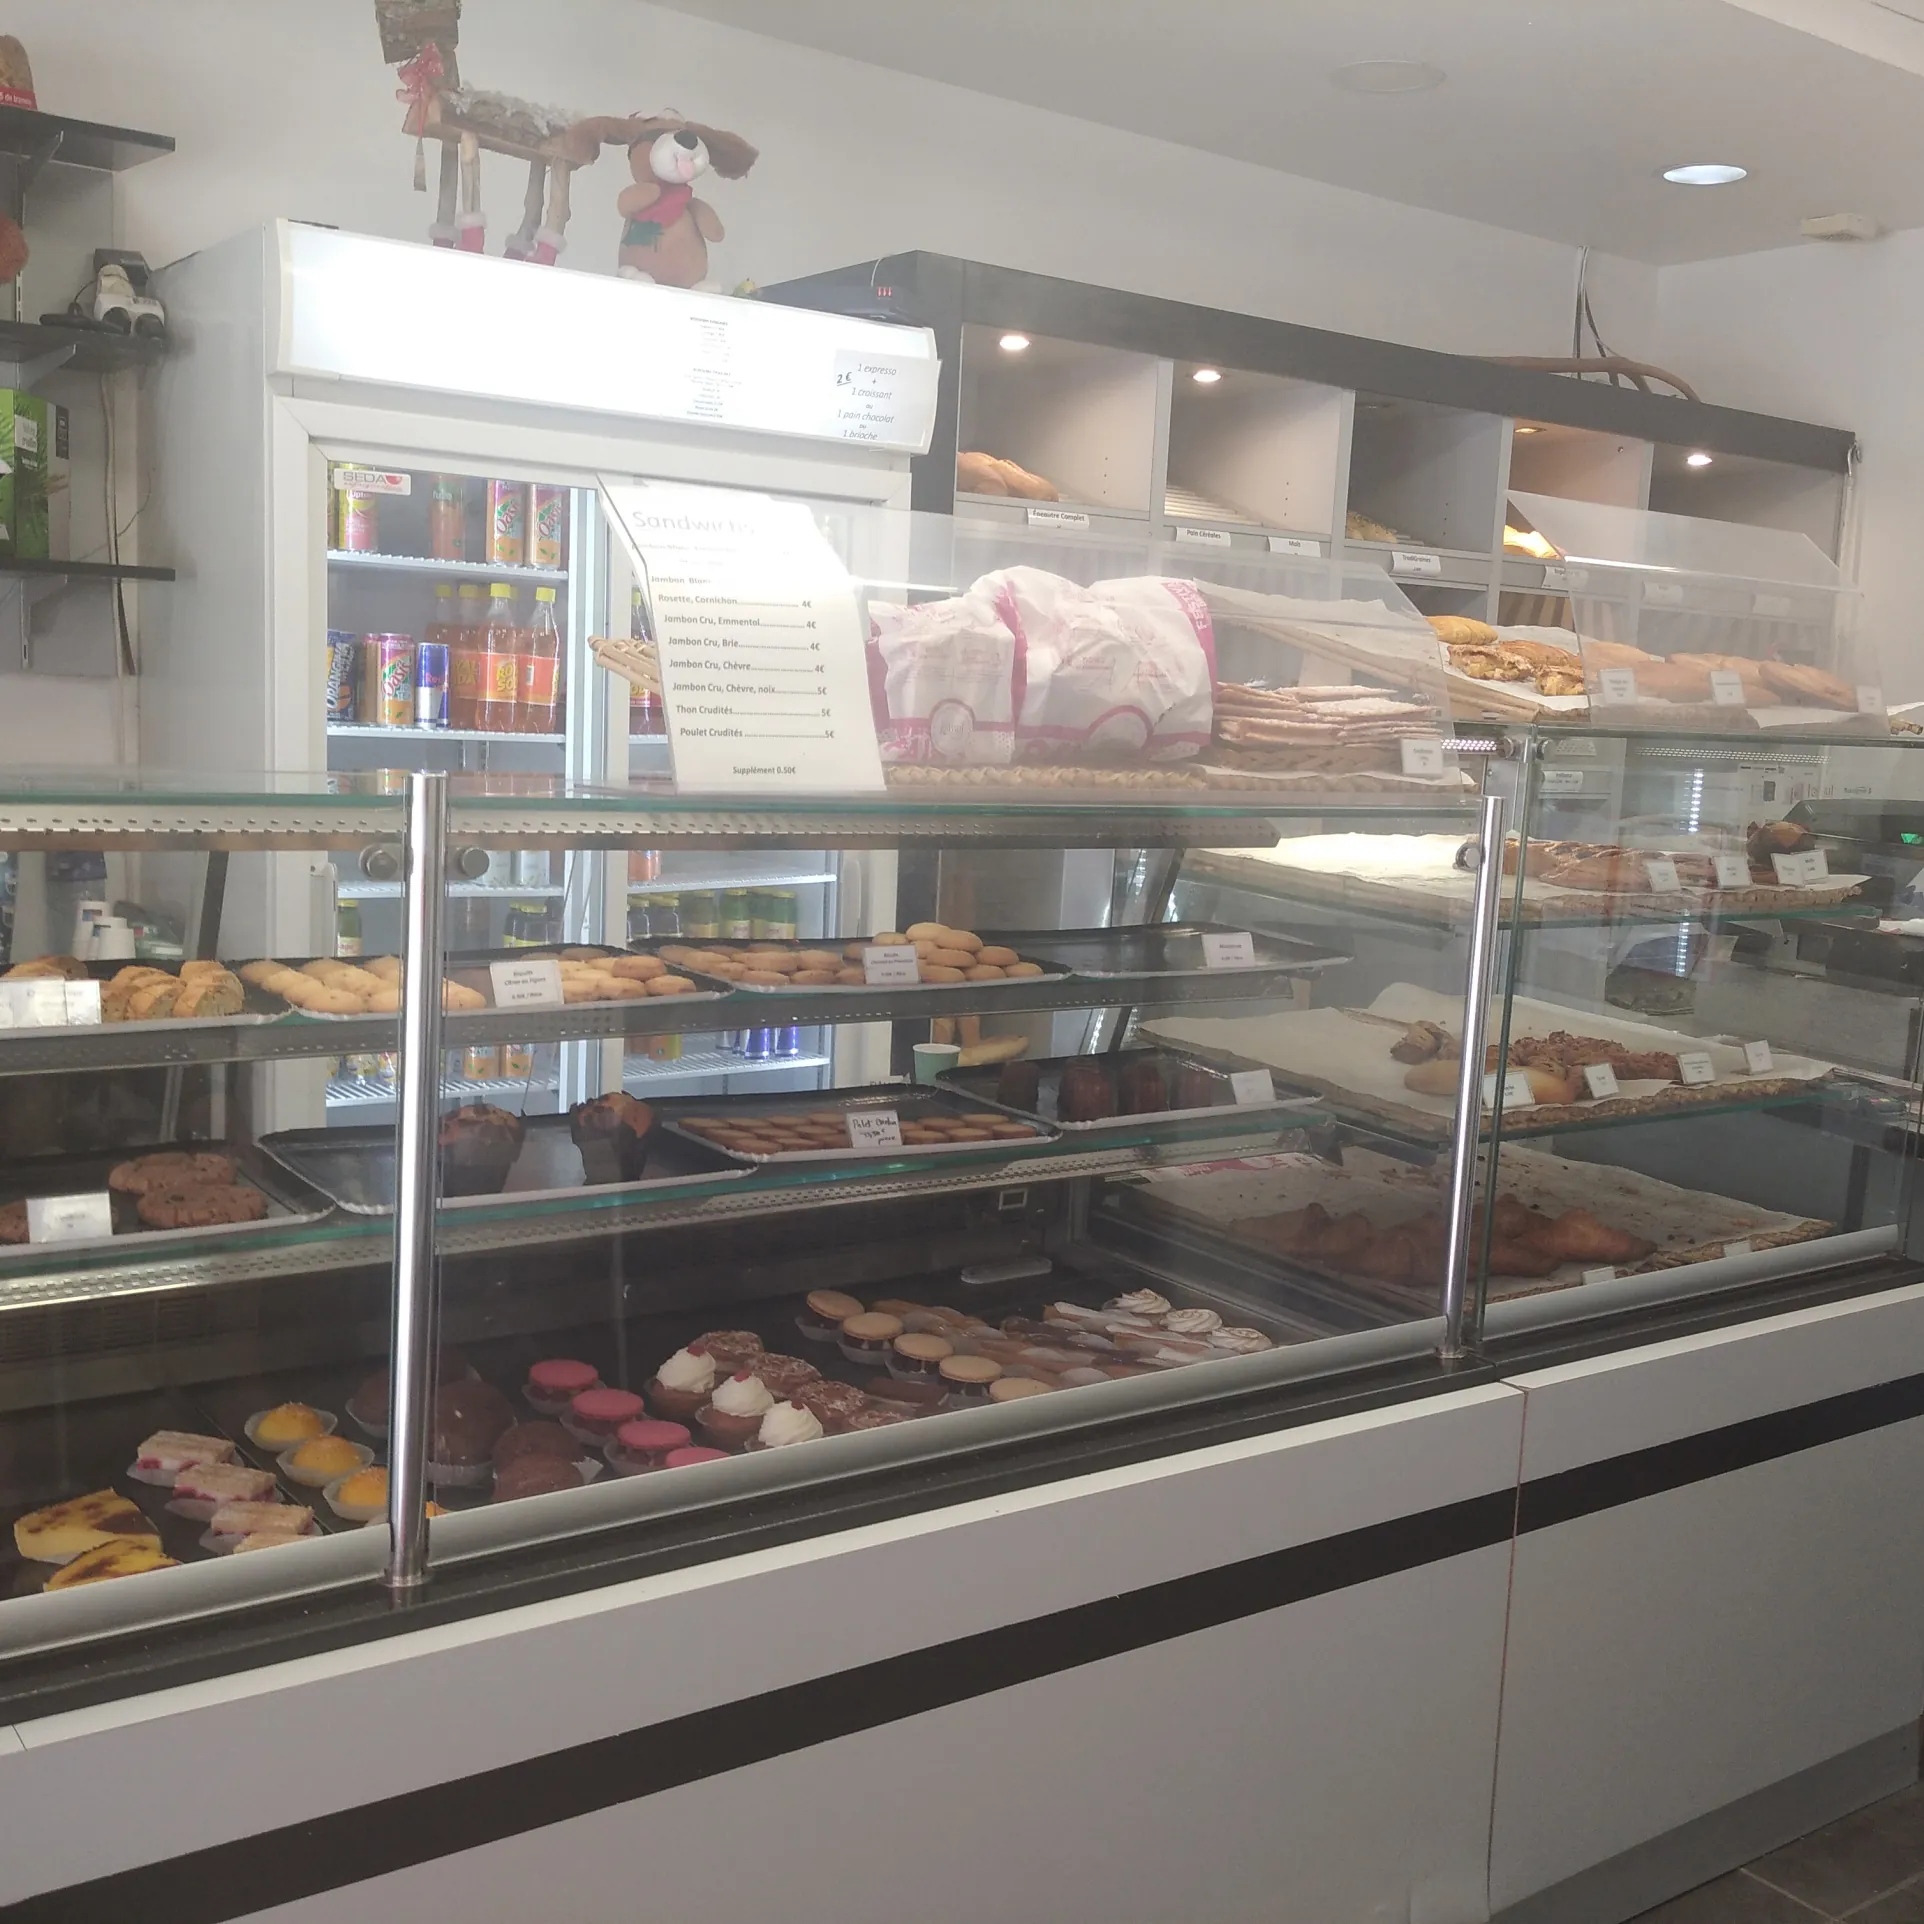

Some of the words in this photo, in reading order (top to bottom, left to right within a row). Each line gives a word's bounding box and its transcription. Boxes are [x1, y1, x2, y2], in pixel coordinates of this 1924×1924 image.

[864, 365, 897, 376] expresso
[837, 374, 843, 384] 2
[858, 389, 892, 400] croissant
[843, 411, 861, 419] pain
[862, 412, 894, 423] chocolat
[849, 430, 878, 440] brioche
[343, 471, 387, 484] SEDA
[1060, 513, 1085, 522] Complet
[1199, 531, 1221, 539] Céréales
[651, 576, 685, 584] Jambon
[658, 594, 694, 604] Rosette,
[695, 596, 738, 605] Cornichon
[664, 614, 698, 624] Jambon
[700, 616, 716, 626] Cru,
[718, 617, 760, 626] Emmental
[806, 621, 816, 629] 4€
[668, 636, 702, 646] Jambon
[703, 638, 720, 648] Cru,
[810, 643, 820, 651] 4€
[669, 659, 703, 669] Jambon
[704, 660, 721, 671] Cru,
[723, 661, 751, 670] Chèvre
[815, 665, 825, 673] 4€
[673, 682, 706, 692] Jambon
[708, 683, 724, 693] Cru,
[726, 684, 756, 694] Chèvre,
[758, 685, 776, 694] noix
[817, 687, 827, 695] 5€
[676, 705, 697, 714] Thon
[699, 705, 733, 715] Crudités
[821, 709, 831, 717] 5€
[680, 727, 707, 737] Poulet
[708, 728, 743, 737] Crudités
[732, 766, 775, 775] Supplément
[776, 766, 796, 774] 0.50€
